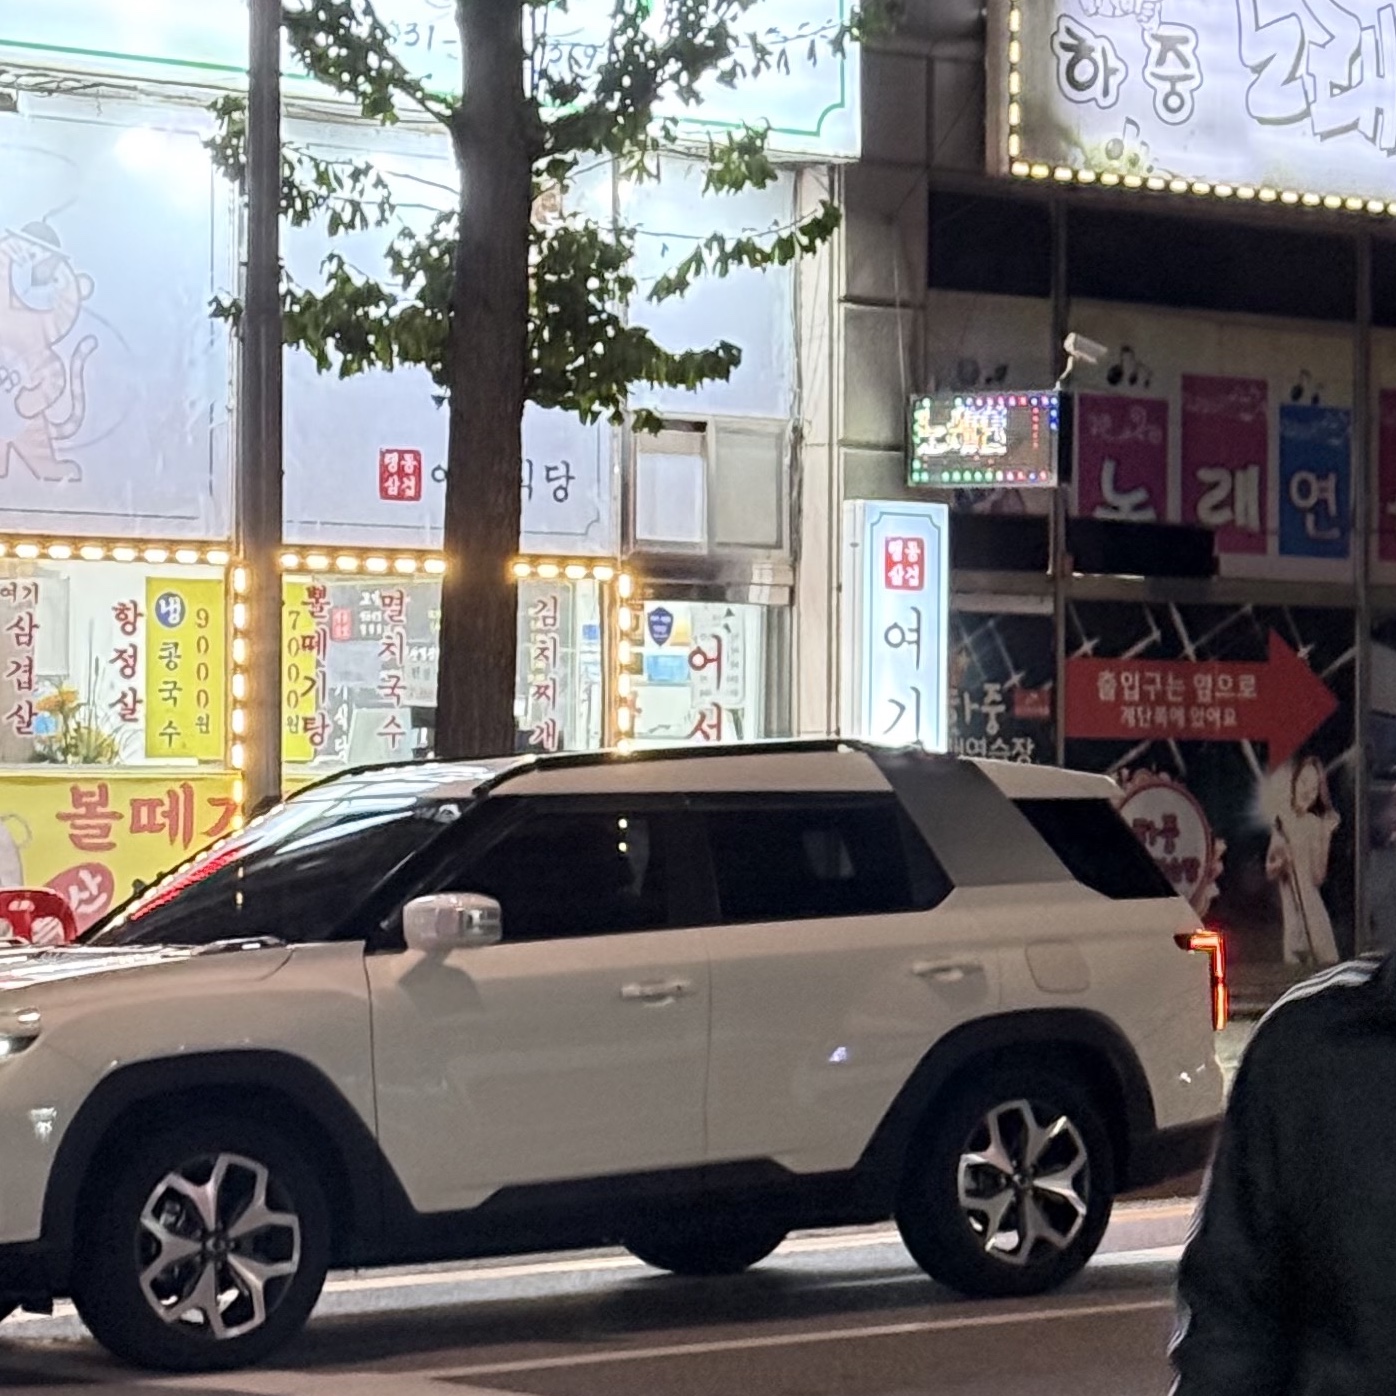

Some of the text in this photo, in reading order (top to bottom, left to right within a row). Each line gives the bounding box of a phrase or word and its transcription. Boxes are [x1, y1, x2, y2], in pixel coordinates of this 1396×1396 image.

[1052, 15, 1201, 124] 하중
[0, 581, 39, 604] 여기
[6, 611, 40, 736] 삼겹살
[108, 599, 144, 723] 항정살
[195, 608, 210, 735] 9000원
[287, 610, 301, 734] 7000원
[377, 589, 407, 749] 멸치국수
[530, 596, 557, 749] 김치찌개
[687, 633, 722, 742] 어서
[884, 606, 921, 738] 여기
[1097, 670, 1186, 702] 출입구는
